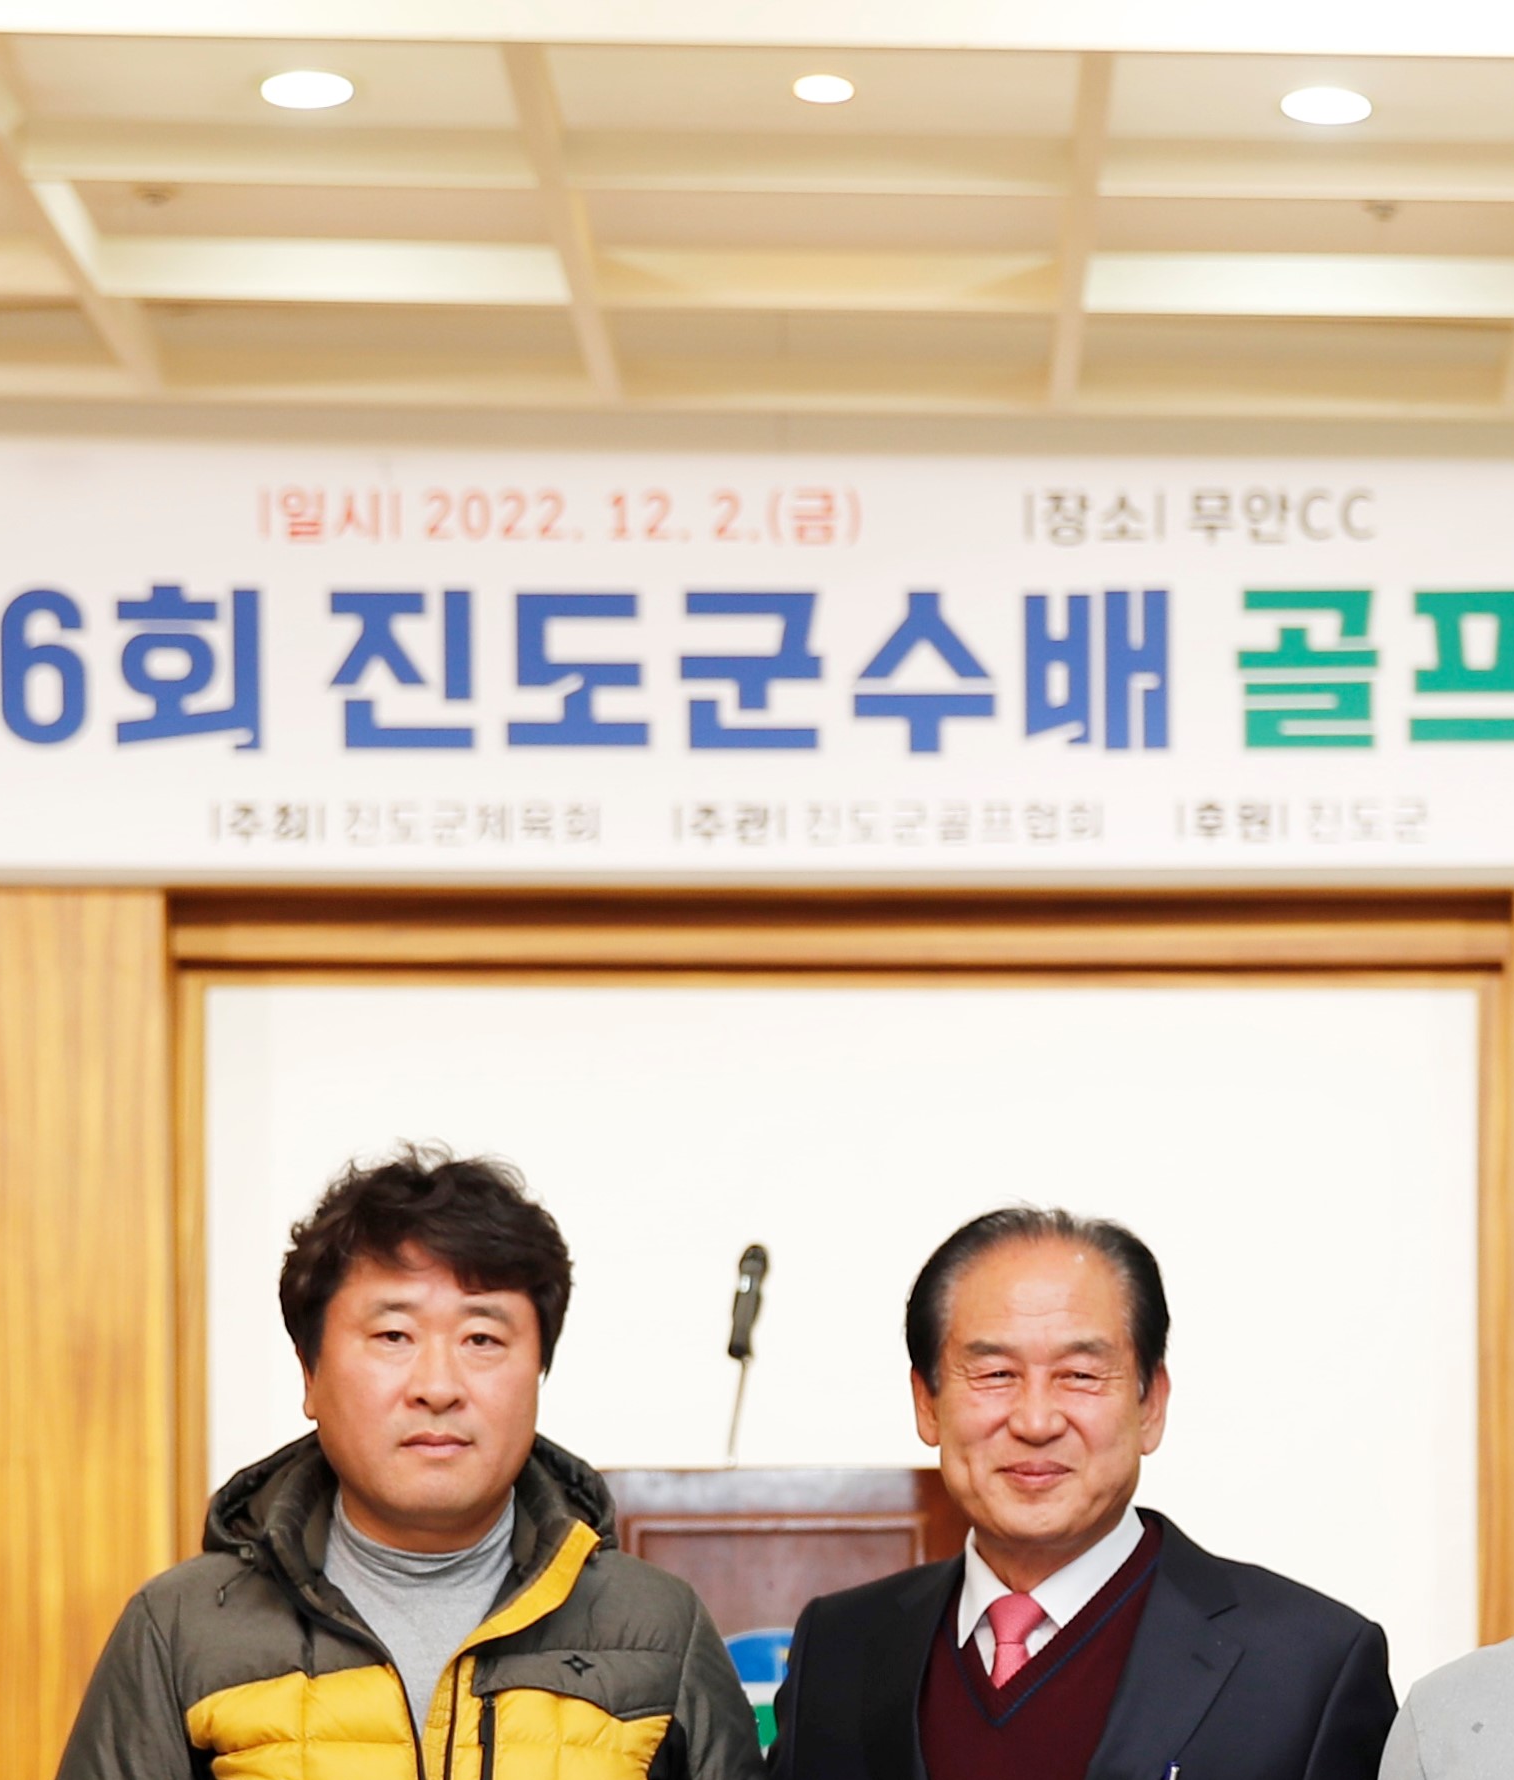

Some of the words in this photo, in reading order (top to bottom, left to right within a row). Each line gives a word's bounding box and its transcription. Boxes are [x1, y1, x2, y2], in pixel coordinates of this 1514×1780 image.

[421, 489, 585, 542] 2022.
[607, 489, 692, 542] 12.
[1191, 488, 1377, 545] 무안CC
[328, 588, 1171, 752] 진도군수배
[344, 802, 601, 847] 진도군체육회
[806, 801, 1104, 846] 진도군골프협회
[1306, 801, 1427, 845] 진도군
